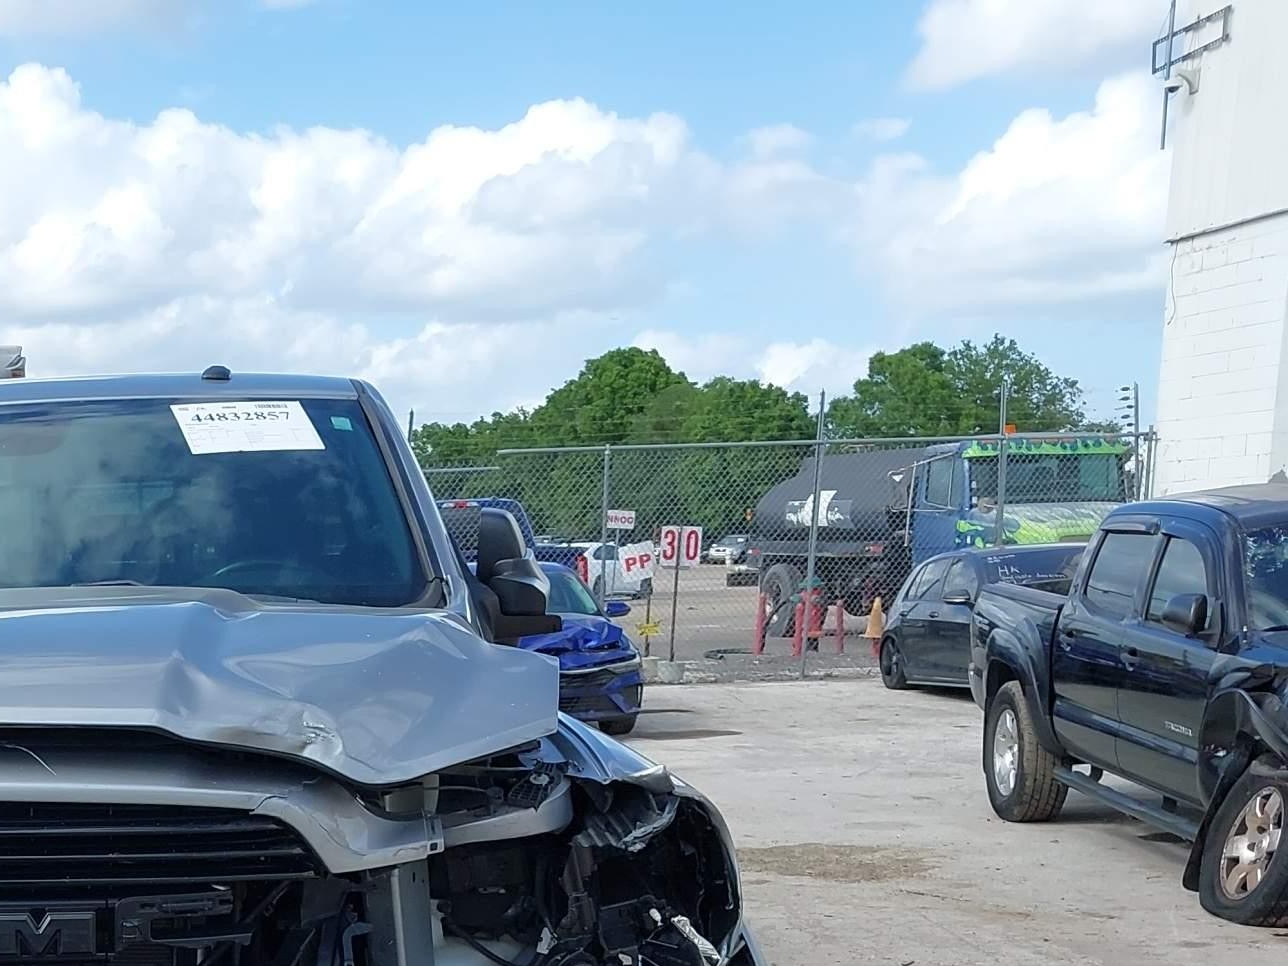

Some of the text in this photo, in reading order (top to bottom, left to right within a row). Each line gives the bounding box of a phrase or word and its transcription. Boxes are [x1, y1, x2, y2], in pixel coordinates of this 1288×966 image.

[191, 411, 290, 423] 44832857
[663, 529, 699, 560] 30
[624, 553, 651, 573] PP
